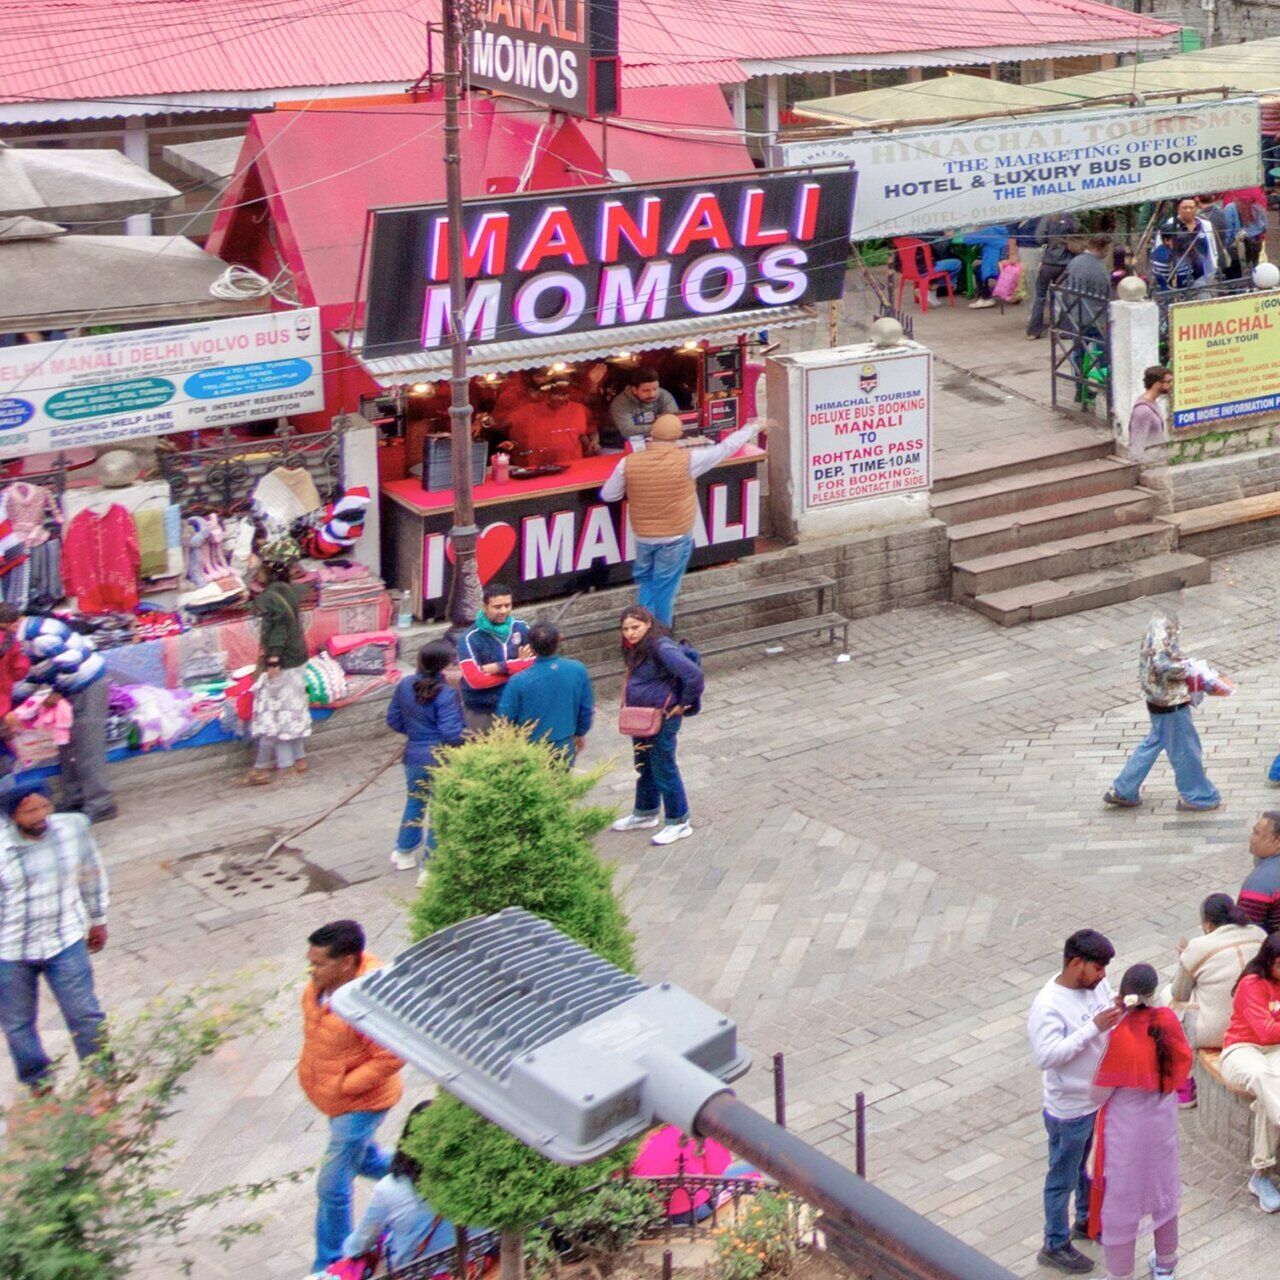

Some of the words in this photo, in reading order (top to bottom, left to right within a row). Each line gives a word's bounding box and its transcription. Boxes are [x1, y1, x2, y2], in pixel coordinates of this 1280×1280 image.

[473, 30, 579, 99] MOMOS
[871, 127, 1070, 165] HIMACHAL
[1082, 109, 1252, 144] TOURISM's
[943, 156, 989, 174] THE
[994, 144, 1120, 170] MARKETING
[1126, 134, 1198, 154] OFFICE
[884, 178, 962, 199] HOTEL
[970, 175, 985, 188] &
[993, 164, 1081, 187] LUXURY
[1089, 157, 1132, 175] BUS
[1138, 144, 1244, 169] BOOKINGS
[993, 187, 1026, 201] THE
[1031, 180, 1076, 197] MALL
[1081, 172, 1142, 190] MANALI
[429, 182, 821, 281] MANALI
[420, 244, 809, 349] MOMOS
[1178, 316, 1273, 342] HIMACHAL
[1206, 335, 1232, 349] DAILY
[1235, 332, 1260, 344] TOUR
[50, 348, 124, 375] MANALI
[130, 343, 184, 363] DELHI
[190, 335, 249, 355] VOLVO
[255, 329, 290, 347] BUS
[188, 406, 207, 415] FOR
[212, 399, 251, 411] INSTANT
[254, 389, 315, 404] RESERVATION
[205, 410, 247, 422] CONTACT
[250, 402, 300, 416] RECEPTION
[810, 409, 851, 425] DELUXE
[854, 405, 875, 419] BUS
[878, 398, 926, 416] BOOKING
[815, 397, 871, 411] HIMACHAL
[874, 389, 921, 403] TOURISM
[1178, 412, 1195, 424] FOR
[1197, 408, 1220, 421] MORE
[1221, 398, 1274, 417] INFORMATION
[51, 420, 108, 437] BOOKING
[111, 415, 143, 427] HELP
[146, 411, 173, 421] LINE
[834, 414, 903, 436] MANALI
[858, 431, 877, 445] TO
[812, 445, 884, 466] ROHTANG
[888, 438, 923, 454] PASS
[814, 465, 845, 481] DEP.
[817, 478, 844, 491] FOR
[849, 467, 919, 486] BOOKING:-
[812, 488, 847, 503] PLEASE
[848, 480, 890, 496] CONTACT
[892, 478, 901, 487] IN
[904, 475, 924, 486] SIDE
[423, 532, 445, 600] I
[521, 478, 761, 582] MALI
